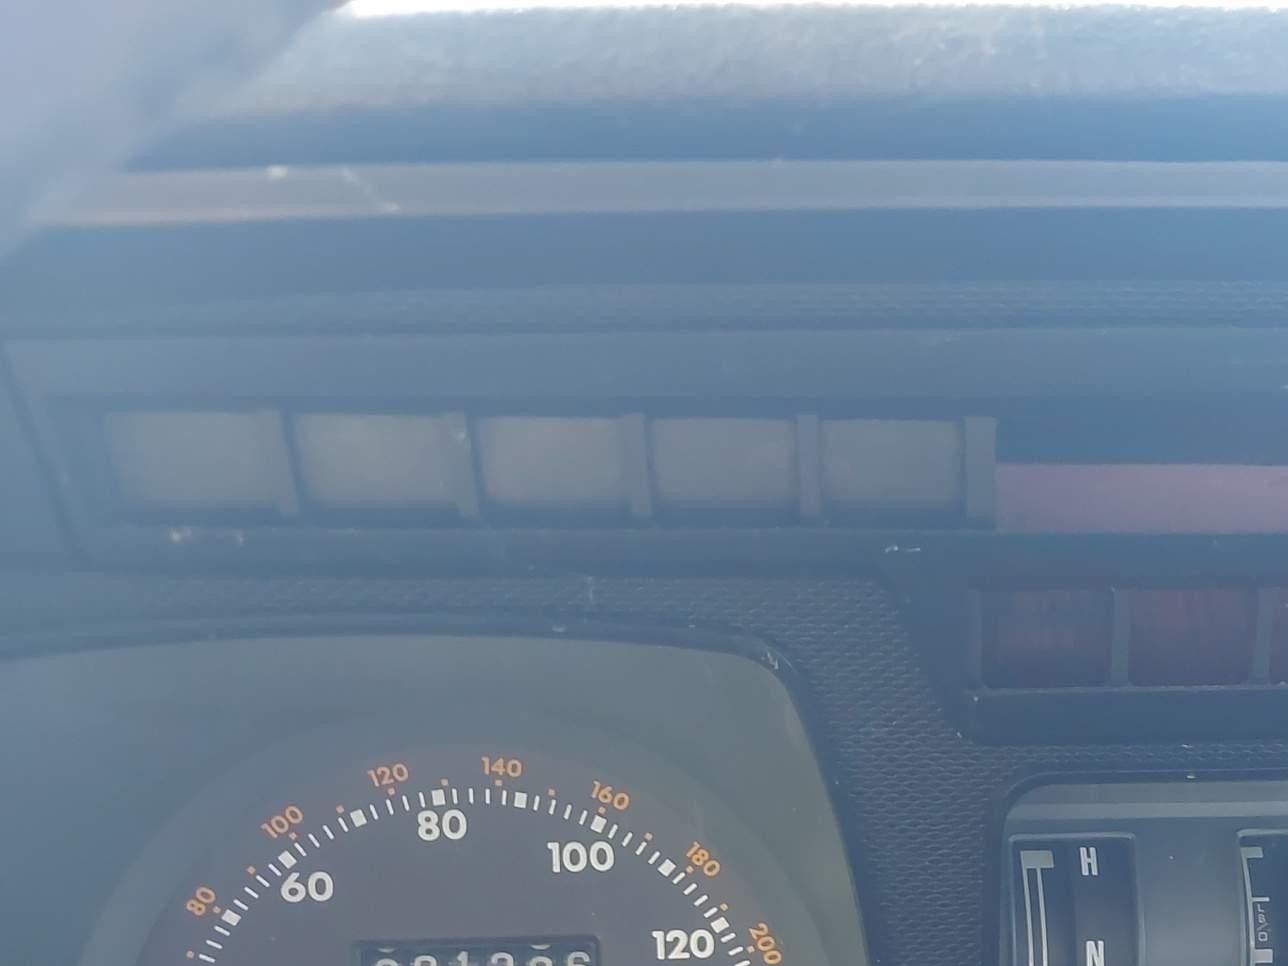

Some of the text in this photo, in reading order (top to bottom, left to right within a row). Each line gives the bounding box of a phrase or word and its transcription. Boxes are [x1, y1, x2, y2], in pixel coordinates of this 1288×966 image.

[368, 763, 409, 787] 120
[481, 757, 522, 777] 140
[591, 780, 629, 810] 160
[261, 805, 303, 838] 100
[417, 810, 467, 841] 80
[547, 841, 615, 873] 100
[686, 841, 720, 877] 180
[1080, 847, 1098, 876] H
[185, 887, 216, 916] 80
[280, 871, 334, 902] 60
[652, 929, 715, 960] 120
[749, 923, 781, 965] 200
